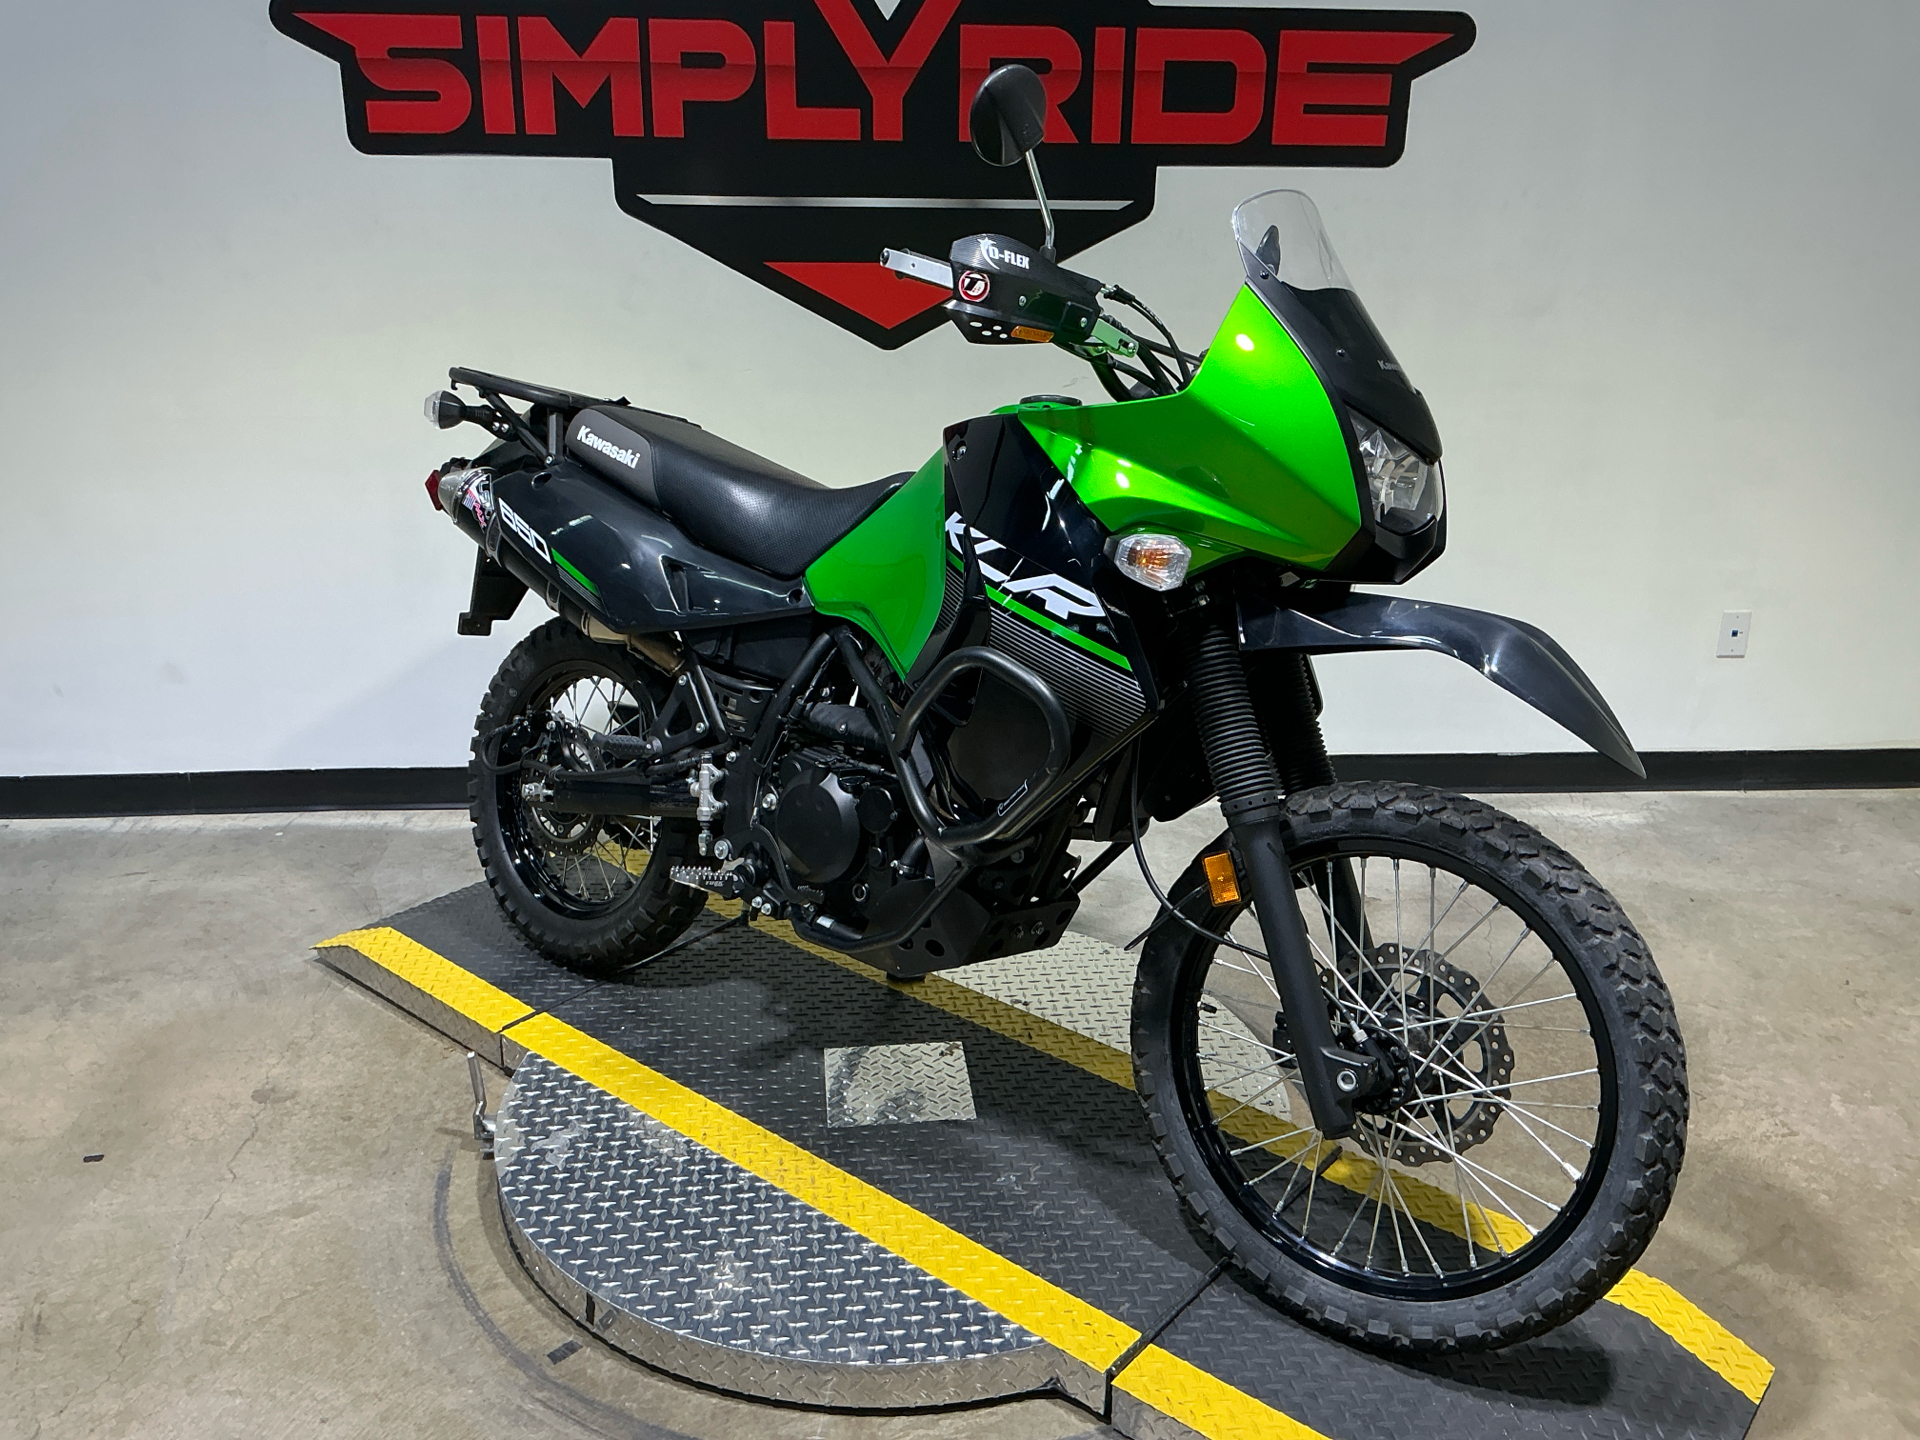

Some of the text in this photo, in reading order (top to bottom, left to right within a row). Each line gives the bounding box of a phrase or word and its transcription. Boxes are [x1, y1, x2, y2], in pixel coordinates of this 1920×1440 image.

[988, 245, 1030, 270] D-FLEX
[576, 424, 641, 469] Kawasaki
[498, 497, 552, 565] 650
[945, 511, 1106, 620] KLR
